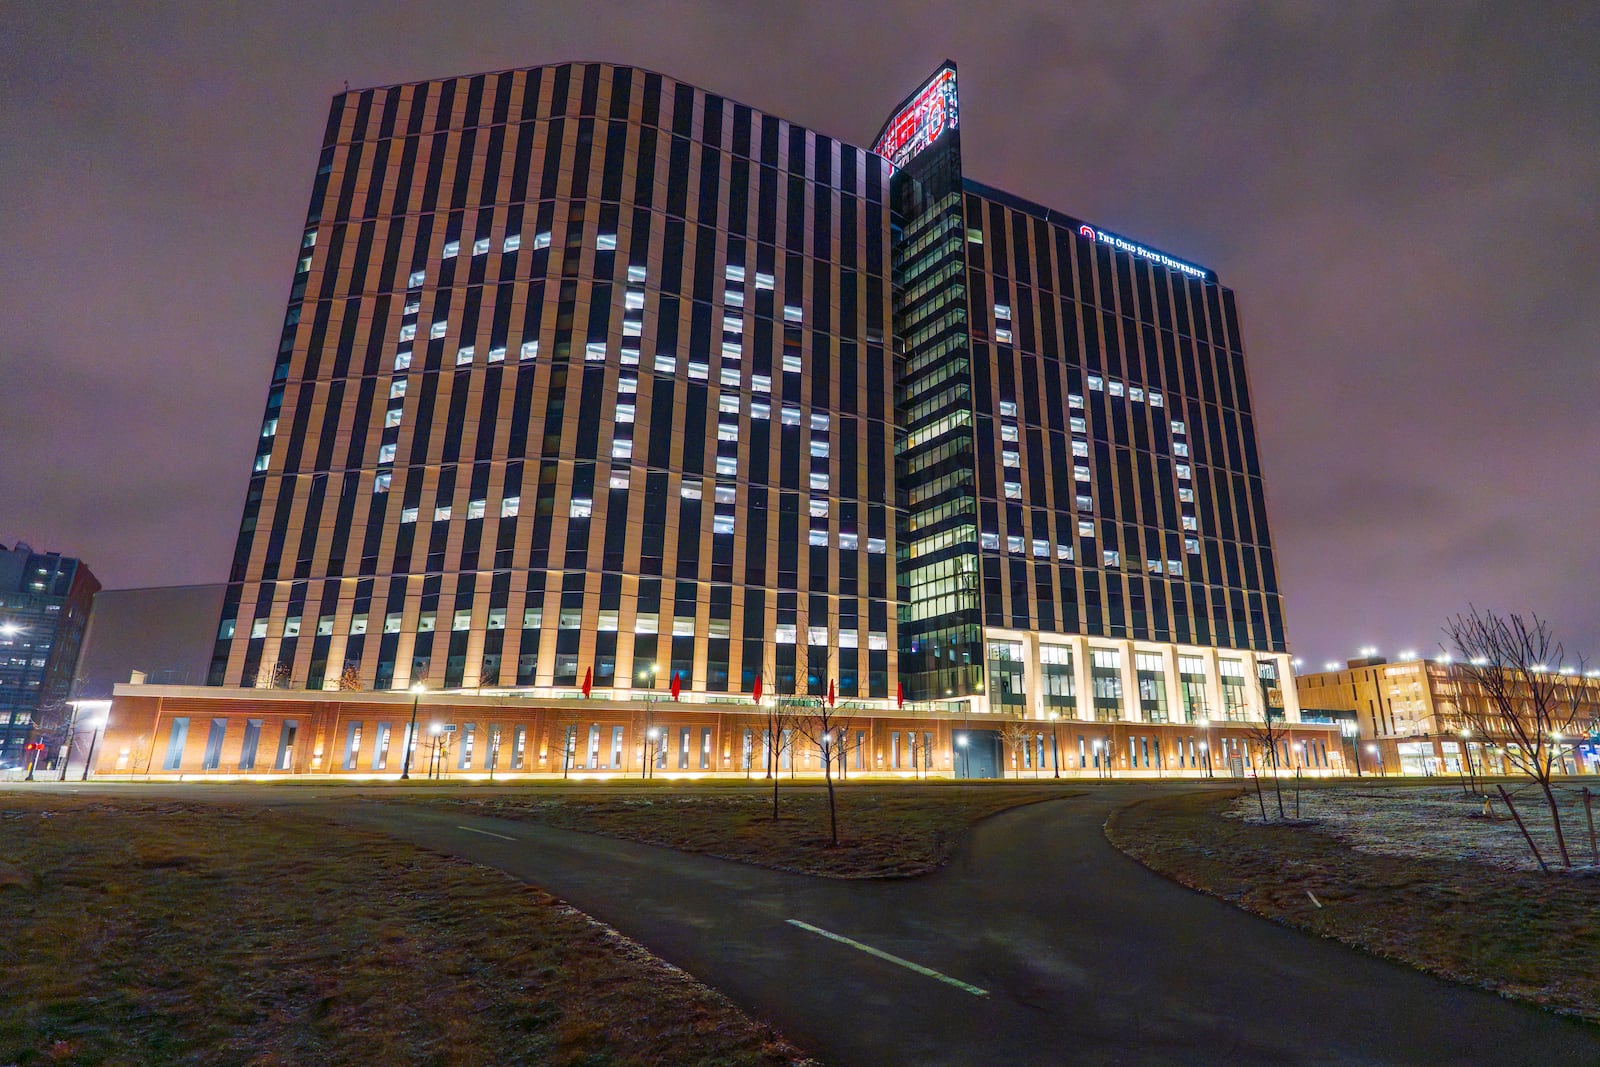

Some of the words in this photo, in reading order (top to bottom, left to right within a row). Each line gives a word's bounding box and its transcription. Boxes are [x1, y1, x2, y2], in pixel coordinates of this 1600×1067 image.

[1097, 231, 1115, 245] THE
[1116, 239, 1136, 253] OHIO
[1137, 246, 1161, 262] STATE
[1161, 255, 1207, 279] UNIVERSITY
